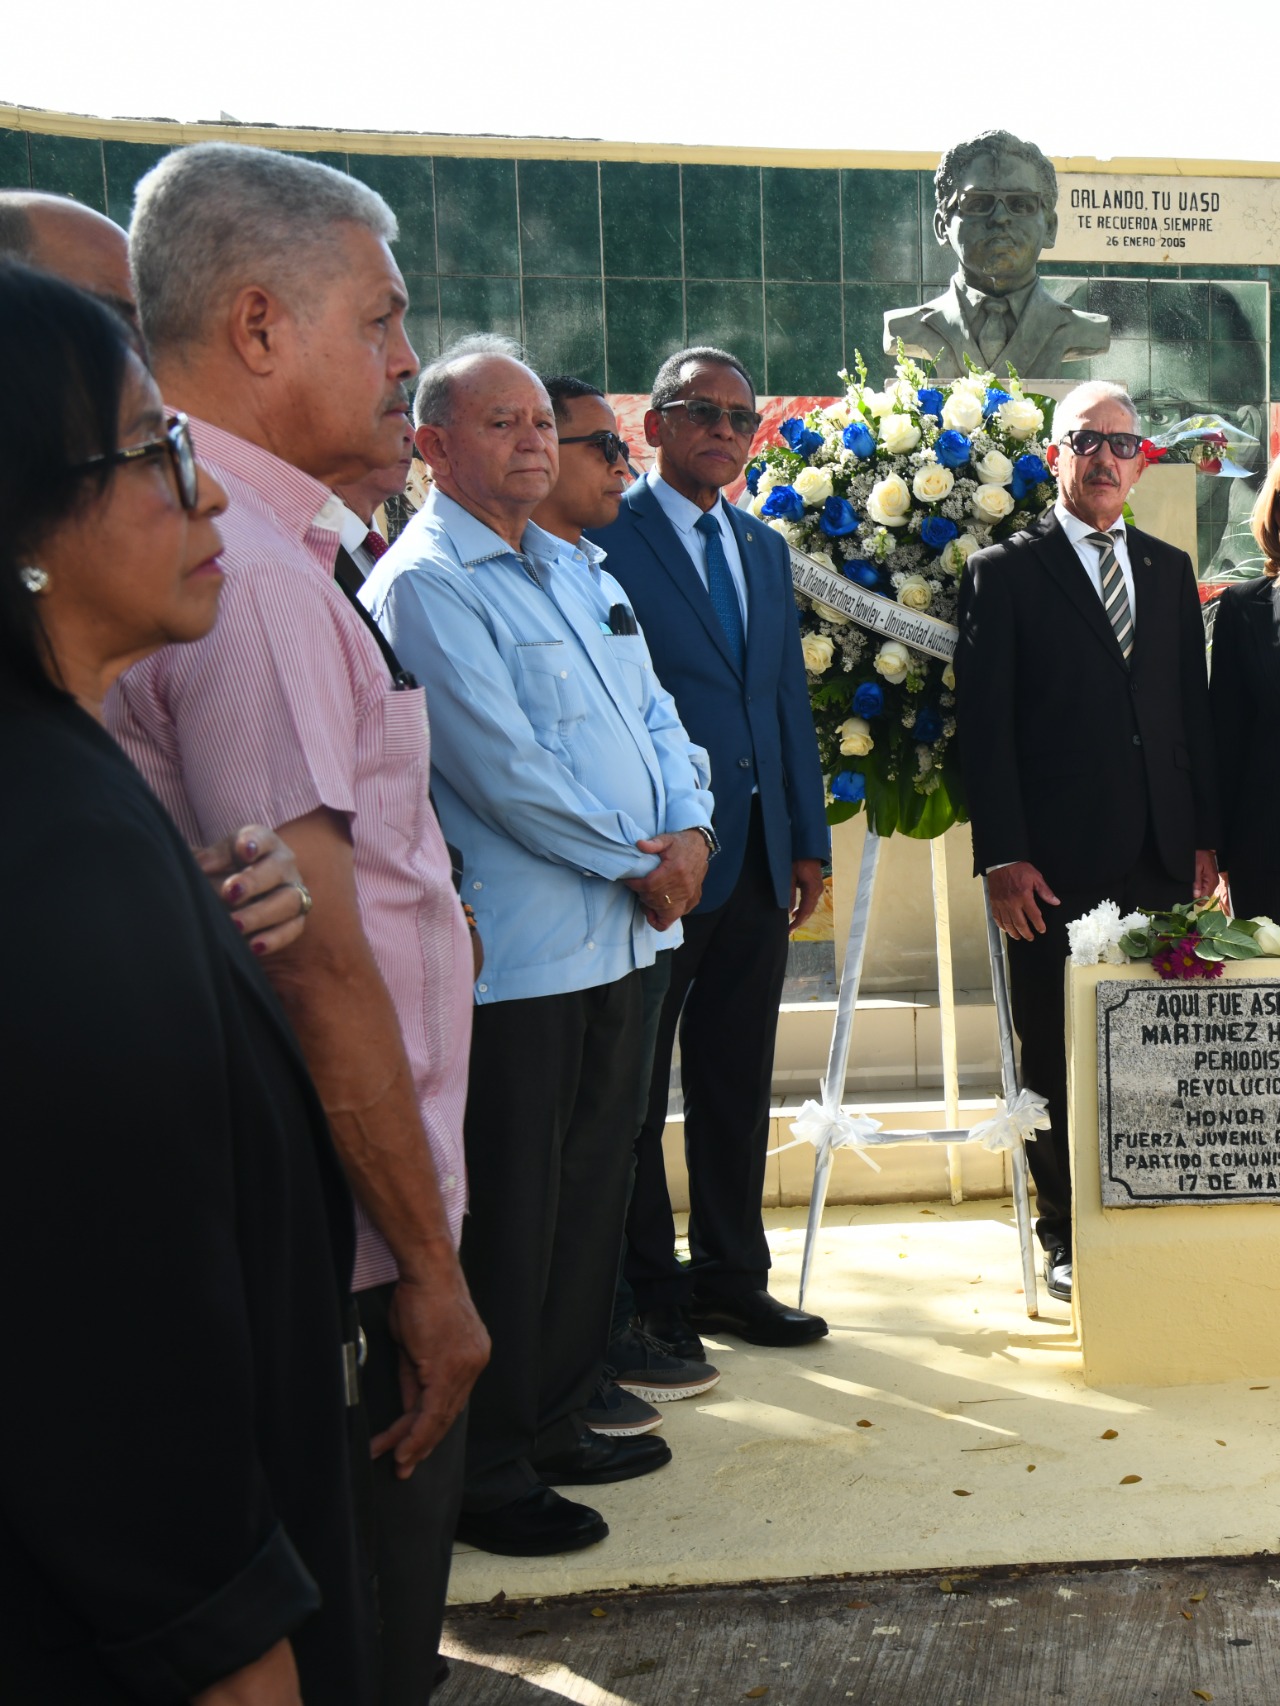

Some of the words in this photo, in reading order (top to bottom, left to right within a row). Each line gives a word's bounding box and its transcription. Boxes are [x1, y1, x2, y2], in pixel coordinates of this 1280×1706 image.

[1152, 191, 1171, 210] TU
[1179, 192, 1220, 212] UASD
[1078, 215, 1092, 228] TE
[1097, 216, 1158, 230] RECUERDA
[1164, 217, 1213, 232] SIEMPRE
[1106, 236, 1119, 247] 26
[1124, 236, 1156, 247] ENERO
[803, 566, 829, 598] Orlando
[825, 580, 855, 613] Martínez
[853, 595, 881, 629] Howley
[884, 609, 931, 646] Universidad
[1207, 993, 1243, 1016] FUE
[1142, 1022, 1258, 1045] MARTINEZ
[1186, 1108, 1264, 1126] HONOR
[1114, 1132, 1187, 1150] FUERZA
[1195, 1130, 1267, 1147] JUVENIL
[1125, 1153, 1202, 1169] PARTIDO
[1178, 1173, 1198, 1192] 17
[1207, 1172, 1236, 1191] DE
